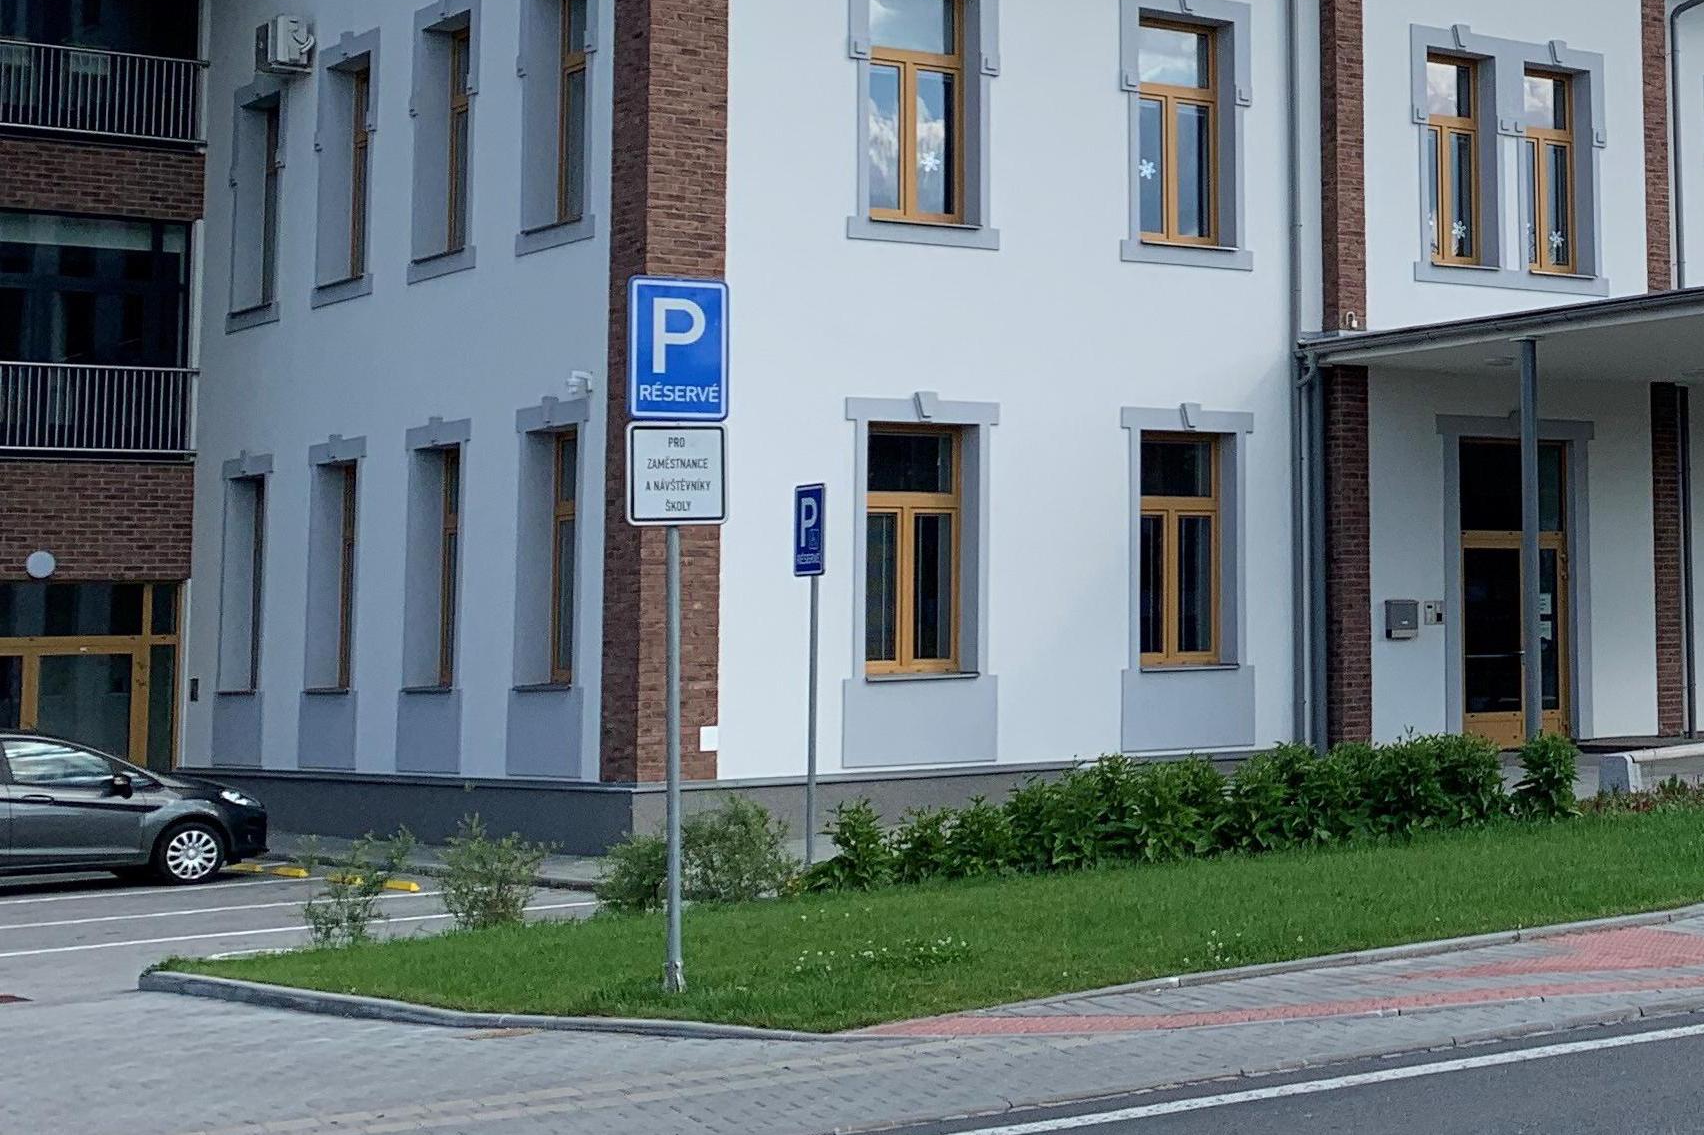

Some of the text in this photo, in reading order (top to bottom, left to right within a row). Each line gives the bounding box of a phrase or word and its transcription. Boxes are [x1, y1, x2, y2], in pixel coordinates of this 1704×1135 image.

[653, 297, 706, 374] P
[640, 381, 720, 403] RÉSERVÉ
[668, 436, 685, 448] PRO
[647, 456, 708, 469] ZAMĚSTNANCE
[645, 480, 651, 491] A
[665, 499, 691, 512] ŠKOLY
[800, 497, 818, 547] P
